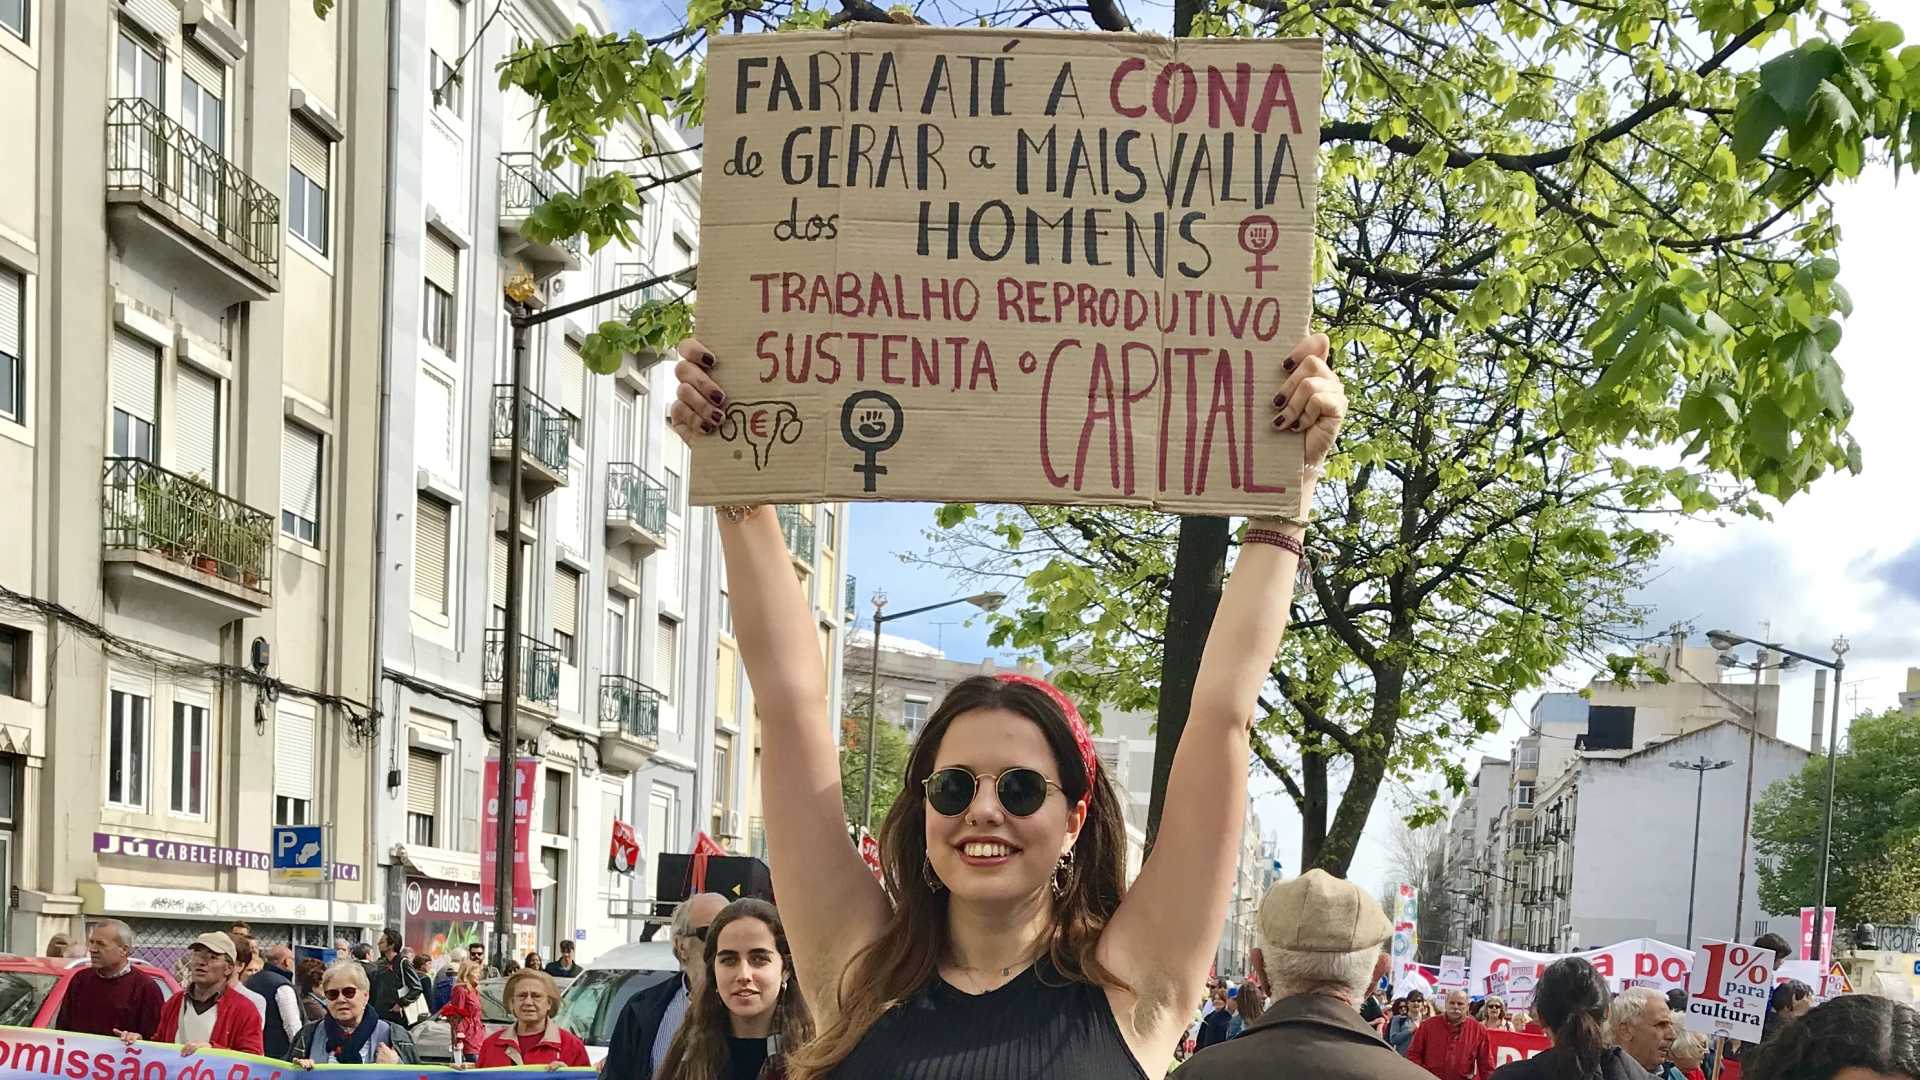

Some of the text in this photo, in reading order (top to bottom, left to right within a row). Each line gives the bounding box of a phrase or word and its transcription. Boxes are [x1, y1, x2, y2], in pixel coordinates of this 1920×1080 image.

[735, 40, 1304, 135] FARTA ATÉ A CONA
[723, 136, 764, 178] de
[781, 123, 948, 191] GERAR
[968, 145, 996, 170] a
[773, 197, 1212, 279] dos HOMENS
[750, 271, 1281, 341] TRABALHO REPRODUTIVO
[756, 330, 1286, 496] SUSTENTA o CAPITAL
[278, 831, 298, 857] P
[426, 887, 461, 913] Caldos
[462, 891, 471, 914] &
[1724, 981, 1765, 998] para
[1733, 996, 1745, 1009] a
[1690, 1002, 1761, 1026] cultura
